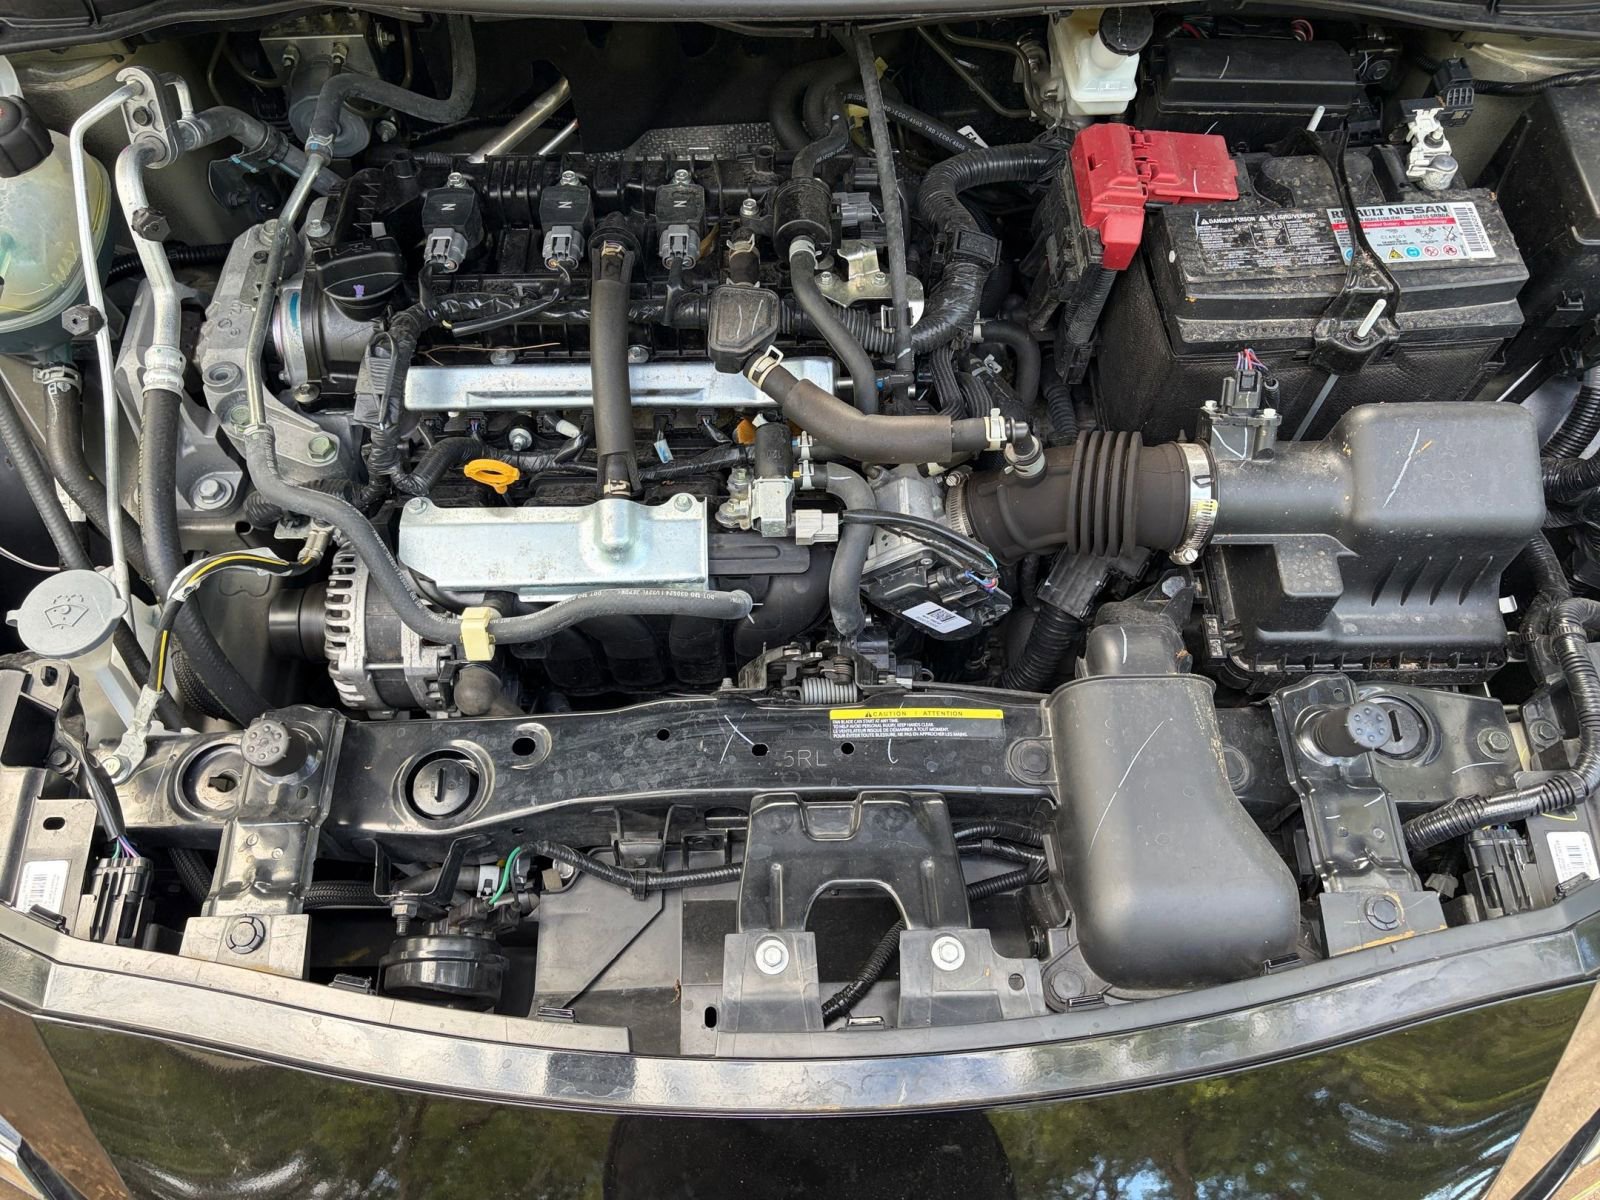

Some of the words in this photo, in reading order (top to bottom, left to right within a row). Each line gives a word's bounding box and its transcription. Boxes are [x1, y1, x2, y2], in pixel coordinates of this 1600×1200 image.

[1388, 205, 1448, 215] NISSAN
[1208, 216, 1256, 224] DANGER/POISON
[783, 749, 827, 768] 5RL
